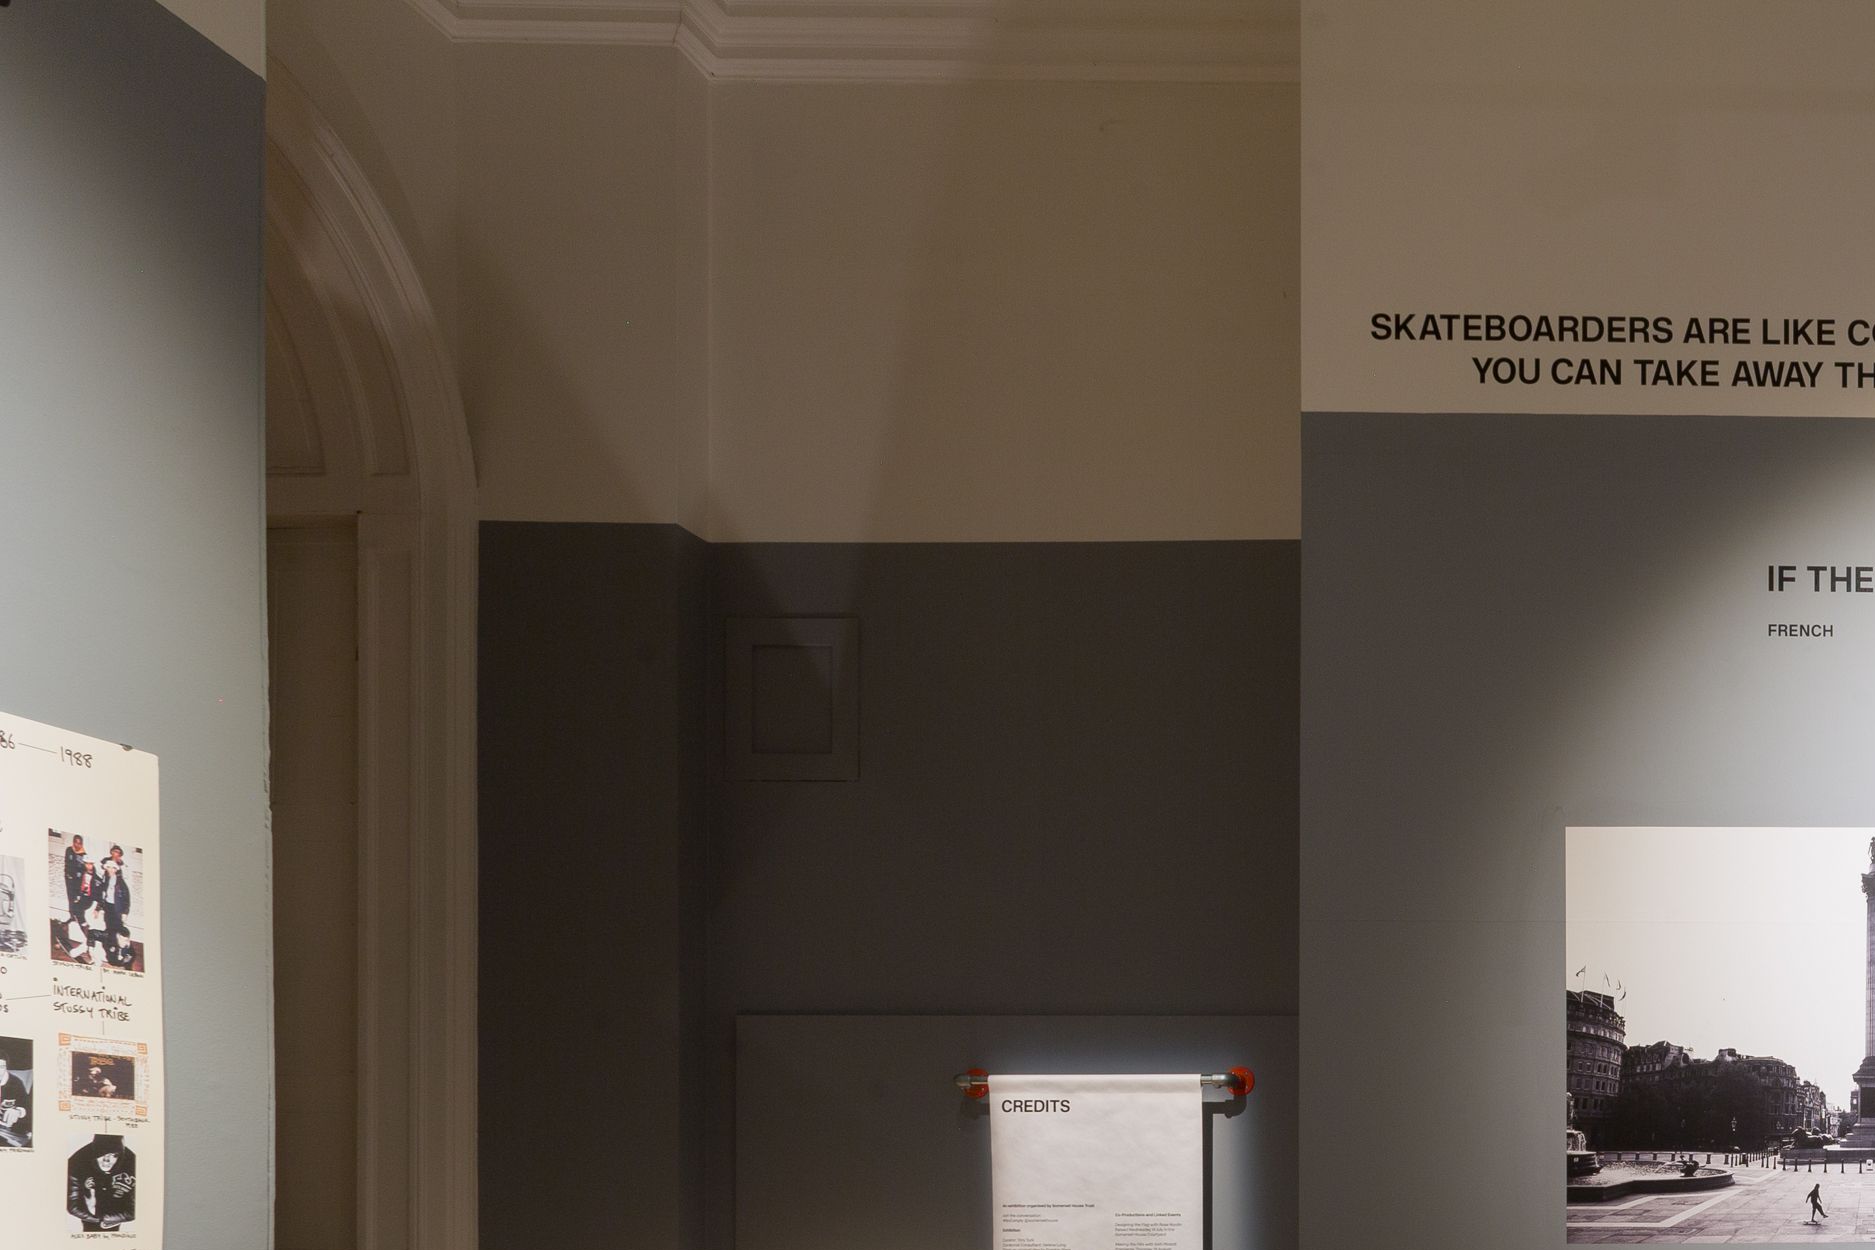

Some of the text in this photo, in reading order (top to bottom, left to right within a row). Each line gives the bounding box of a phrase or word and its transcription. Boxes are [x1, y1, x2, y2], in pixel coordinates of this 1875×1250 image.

[1370, 313, 1674, 344] SKATEBOARDERS
[1683, 317, 1751, 345] ARE
[1762, 318, 1837, 347] LIKE
[1471, 357, 1540, 385] YOU
[1551, 358, 1622, 386] CAN
[1634, 359, 1720, 387] TAKE
[1731, 360, 1824, 388] AWAY
[1768, 566, 1797, 592] IF
[1768, 623, 1833, 638] FRENCH
[60, 746, 93, 768] 1988
[53, 977, 132, 1007] INTERNATIONAL
[53, 1002, 130, 1022] STUSSY TRIBE
[1001, 1099, 1071, 1113] CREDITS
